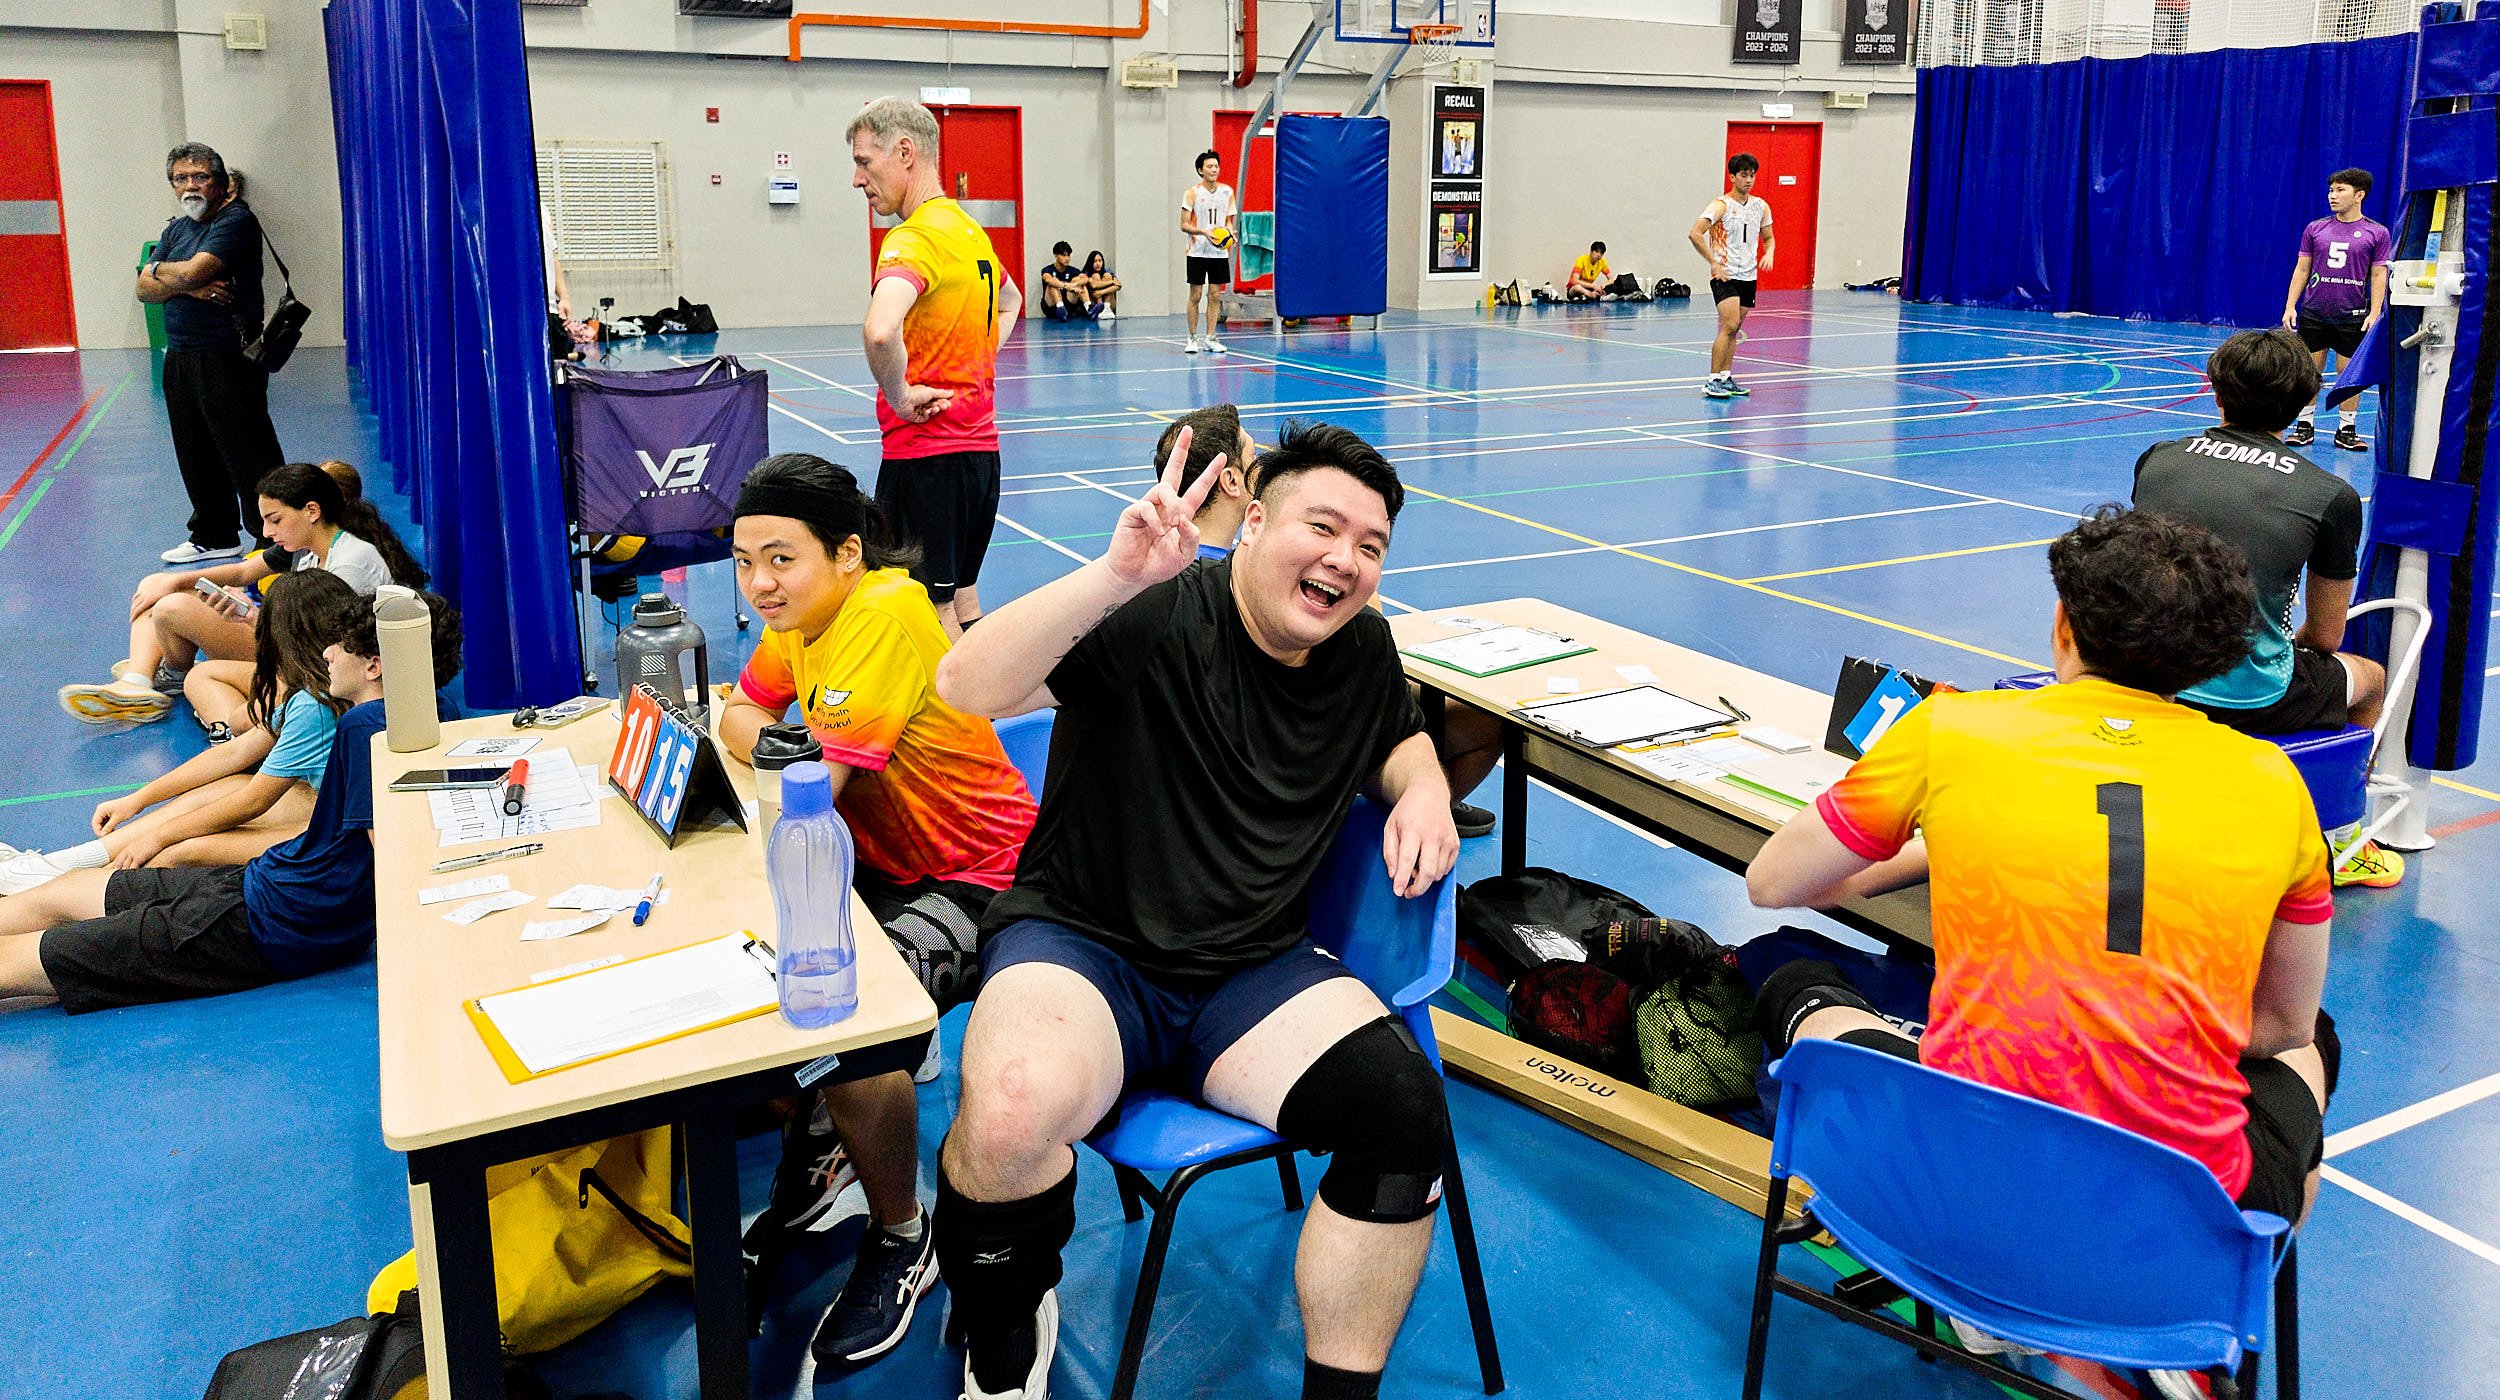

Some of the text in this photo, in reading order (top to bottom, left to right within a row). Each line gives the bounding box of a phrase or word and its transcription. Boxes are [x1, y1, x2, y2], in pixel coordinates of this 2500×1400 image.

[1745, 31, 1789, 42] CHAMPIONS
[1855, 33, 1896, 43] CHAMPIONS
[1745, 43, 1763, 52] 2023
[1769, 43, 1788, 53] 2024
[1854, 44, 1872, 53] 2023
[1878, 45, 1895, 54] 2024
[1444, 94, 1476, 108] RECALL
[1432, 190, 1481, 202] DEMONSTRATE
[1208, 208, 1217, 225] 11
[1742, 223, 1748, 243] 1
[2326, 241, 2350, 269] 5
[976, 259, 994, 337] 7
[2184, 436, 2299, 475] THOMAS
[639, 483, 711, 498] VICTORY
[1859, 693, 1906, 753] 1
[615, 707, 693, 824] 10 15
[2095, 781, 2145, 957] 1
[1525, 1057, 1617, 1097] molten
